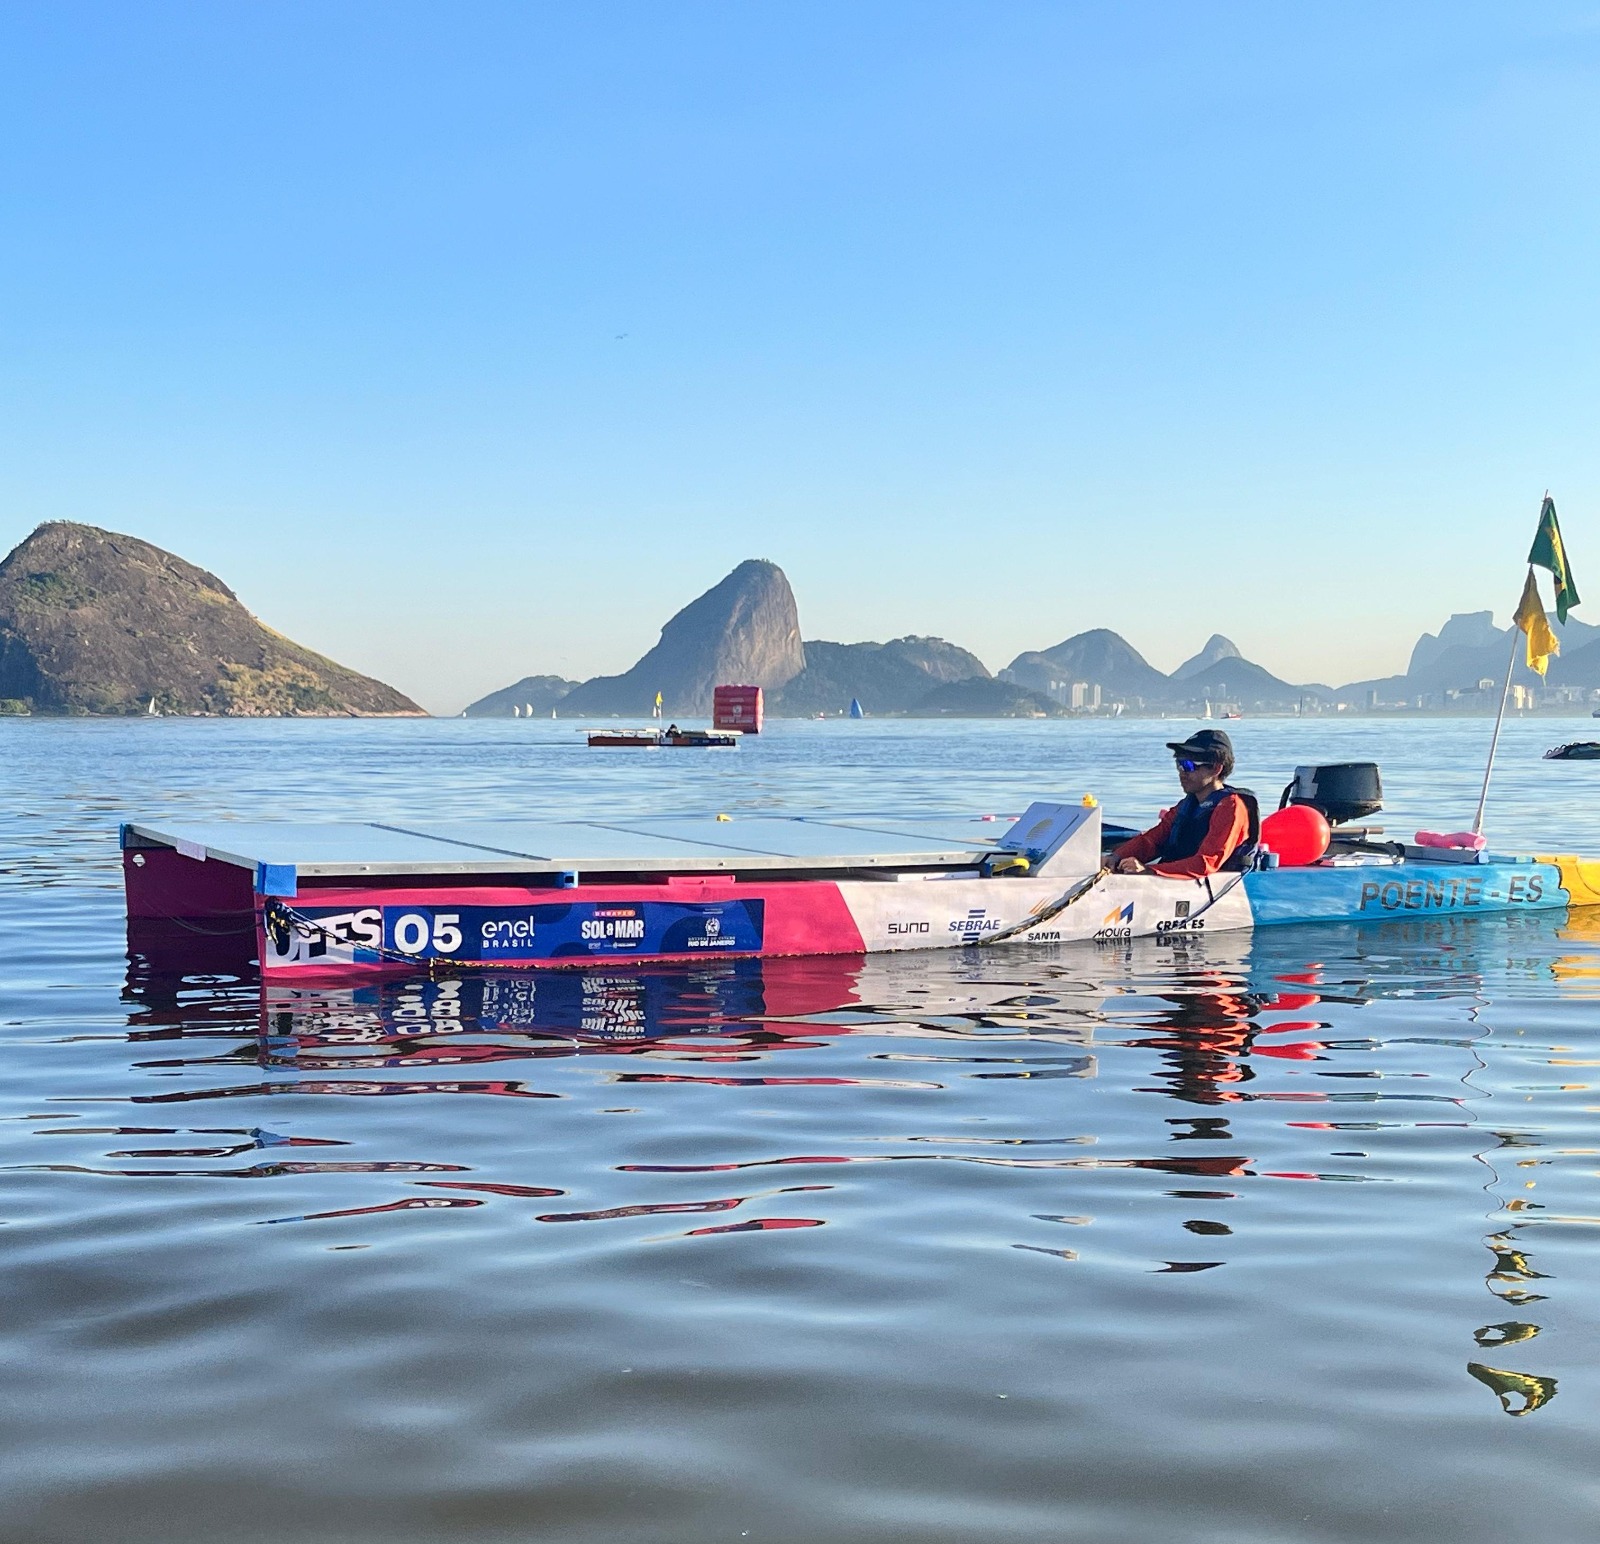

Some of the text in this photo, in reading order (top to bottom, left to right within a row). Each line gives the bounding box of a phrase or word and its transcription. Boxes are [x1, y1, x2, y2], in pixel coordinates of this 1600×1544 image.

[1359, 877, 1483, 911] POENTE
[1507, 874, 1543, 904] ES
[481, 915, 535, 938] enel
[948, 919, 1001, 932] SEBRAE
[394, 913, 463, 954] 05
[1027, 931, 1061, 941] SANTA
[1093, 927, 1131, 938] Moura
[482, 938, 534, 949] BRASIL
